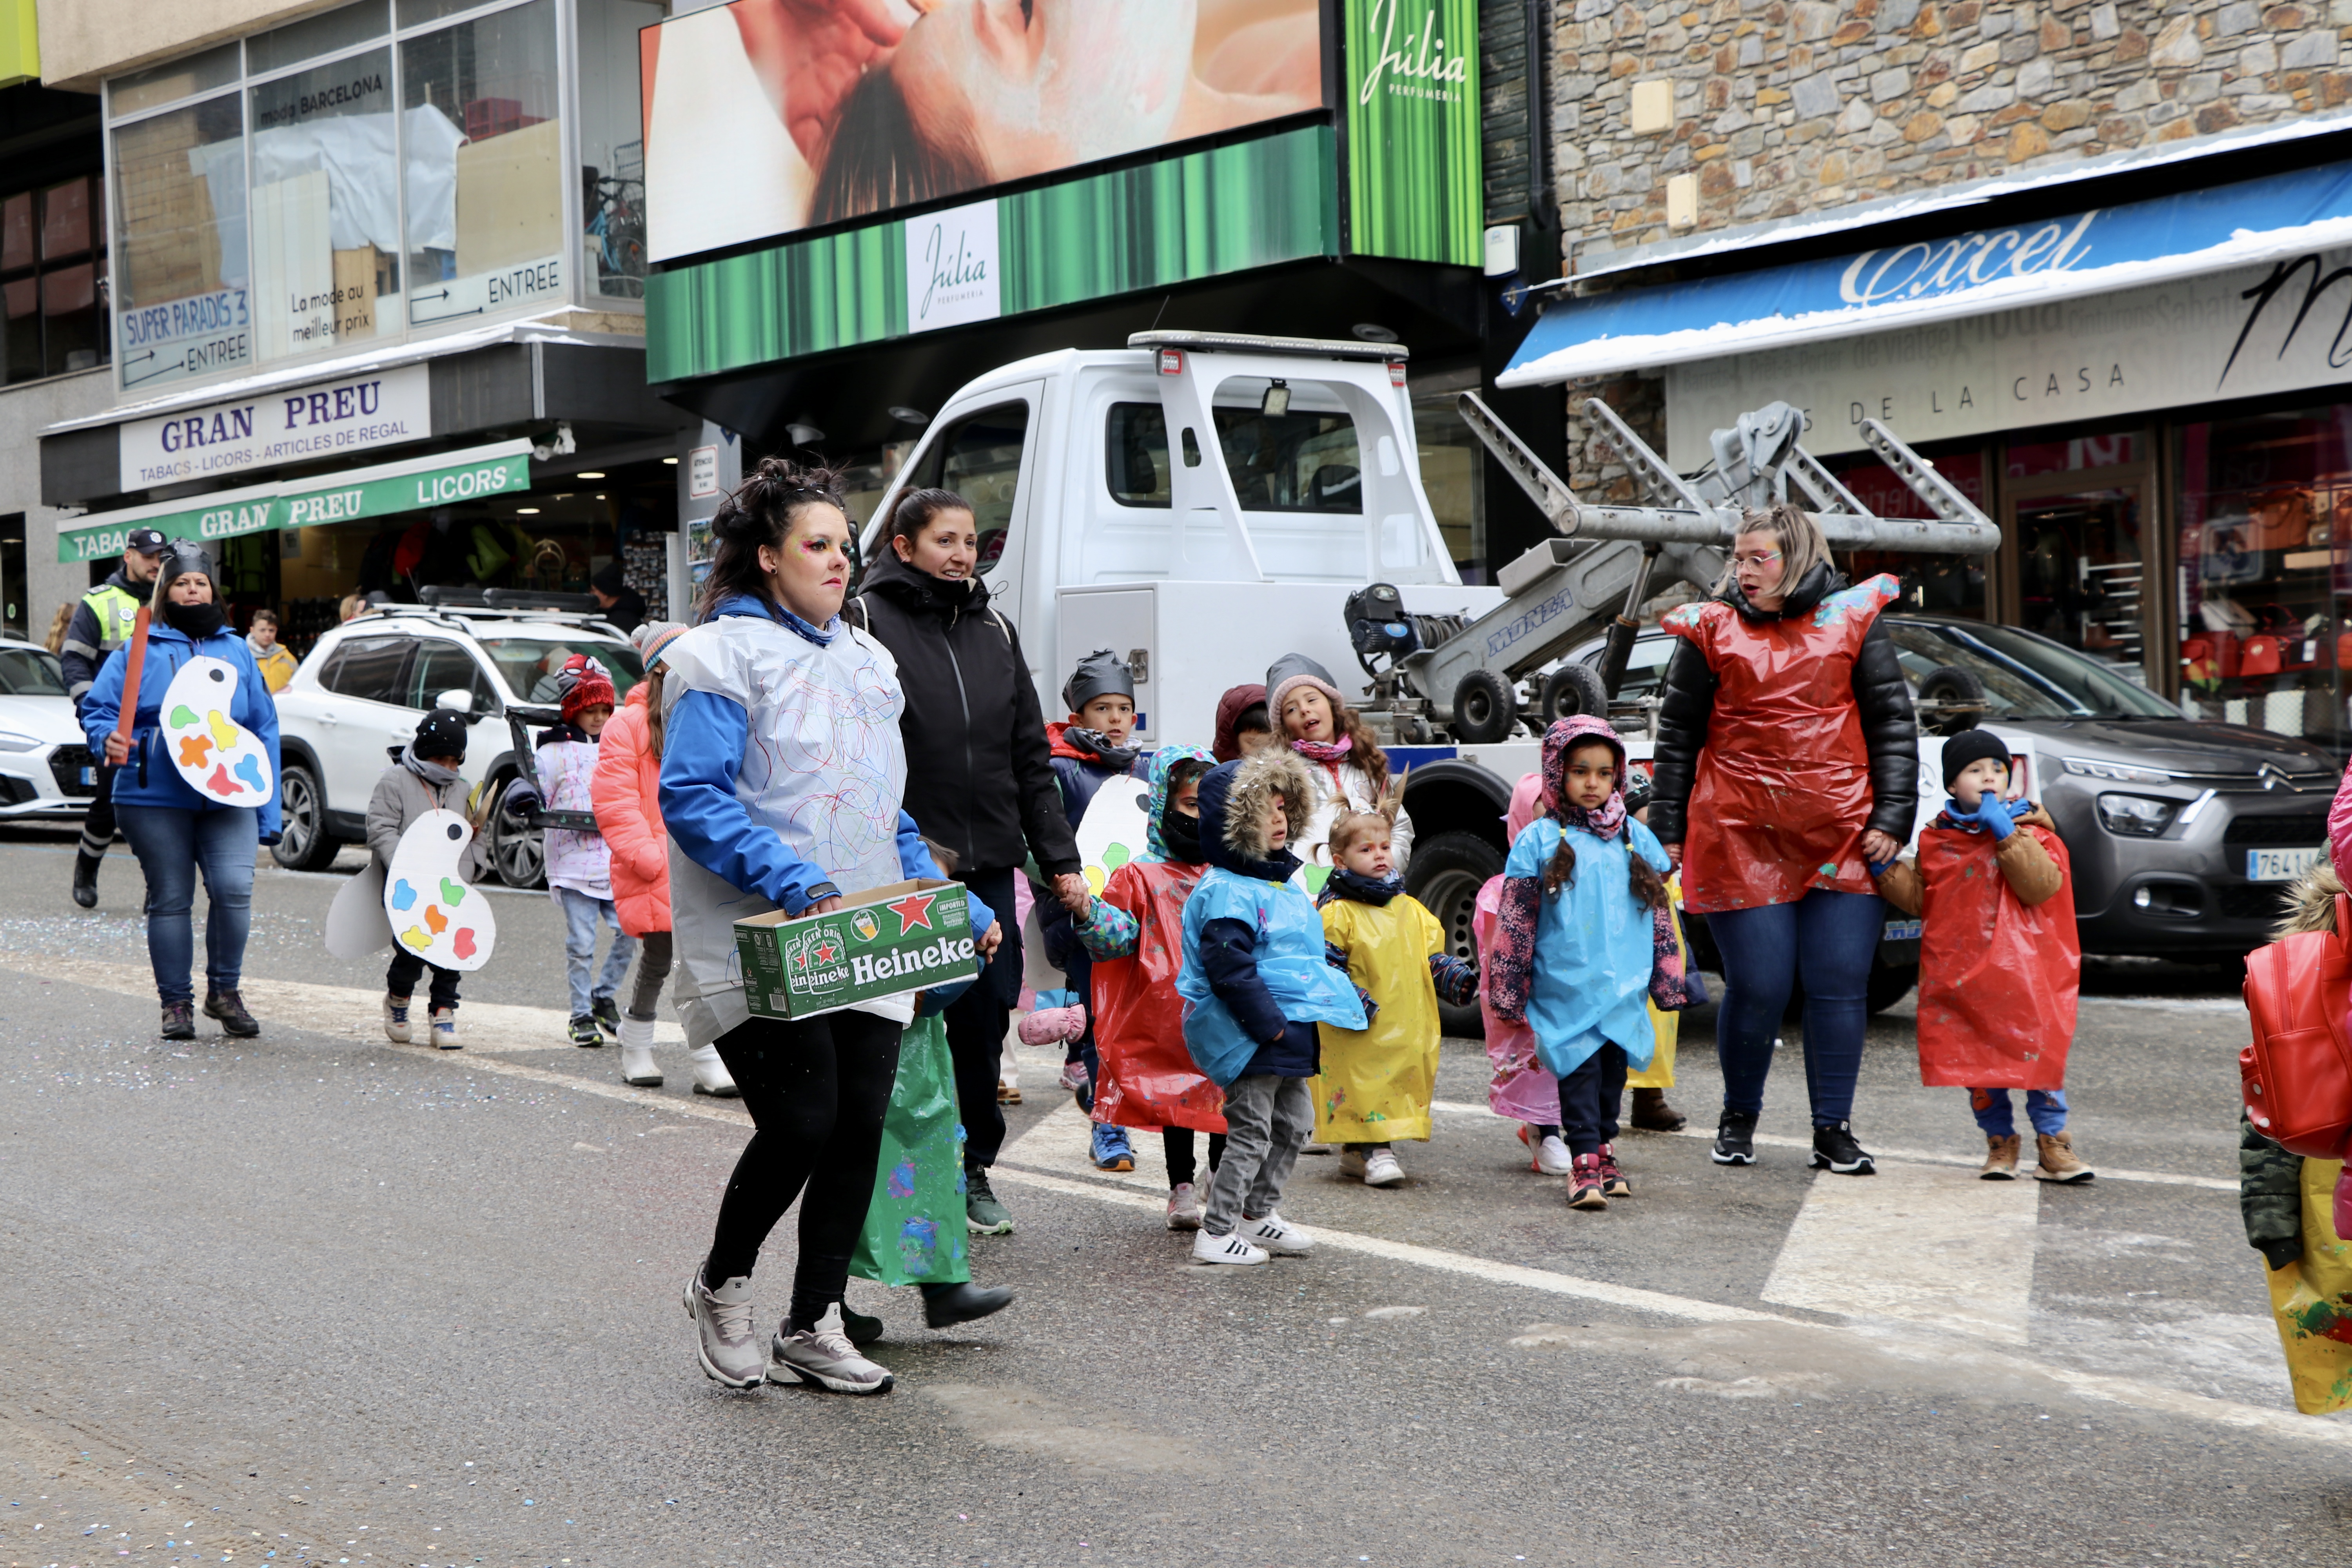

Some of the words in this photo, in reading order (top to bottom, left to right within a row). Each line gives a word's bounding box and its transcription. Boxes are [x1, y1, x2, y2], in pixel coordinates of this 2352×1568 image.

[1360, 0, 1467, 106] Júlia
[261, 103, 296, 125] moda
[300, 73, 383, 114] BARCELONA
[1389, 83, 1461, 102] PERFUMERIA
[489, 261, 559, 304] ENTREE
[920, 223, 987, 319] Júlia
[126, 307, 171, 345] SUPER
[173, 293, 232, 336] PARADIS
[234, 290, 248, 325] 3
[292, 293, 307, 312] La
[310, 283, 344, 308] mode
[348, 285, 363, 300] au
[938, 289, 984, 305] PERFUMERIA
[293, 316, 340, 342] meilleur
[346, 309, 369, 337] prix
[187, 334, 247, 372] ENTREE
[162, 406, 254, 453] GRAN
[284, 381, 381, 430] PREU
[1851, 396, 1893, 425] DE
[1933, 386, 1974, 413] LA
[2014, 363, 2125, 400] CASA
[140, 461, 191, 482] TABACS
[202, 449, 252, 471] LICORS
[264, 434, 332, 459] ARTICLES
[336, 430, 355, 446] DE
[359, 421, 409, 442] REGAL
[417, 466, 508, 505] LICORS
[200, 501, 272, 539] GRAN
[289, 490, 363, 525] PREU
[1487, 588, 1573, 657] MONZA
[2260, 853, 2301, 876] 7641
[939, 900, 965, 912] IMPORTED
